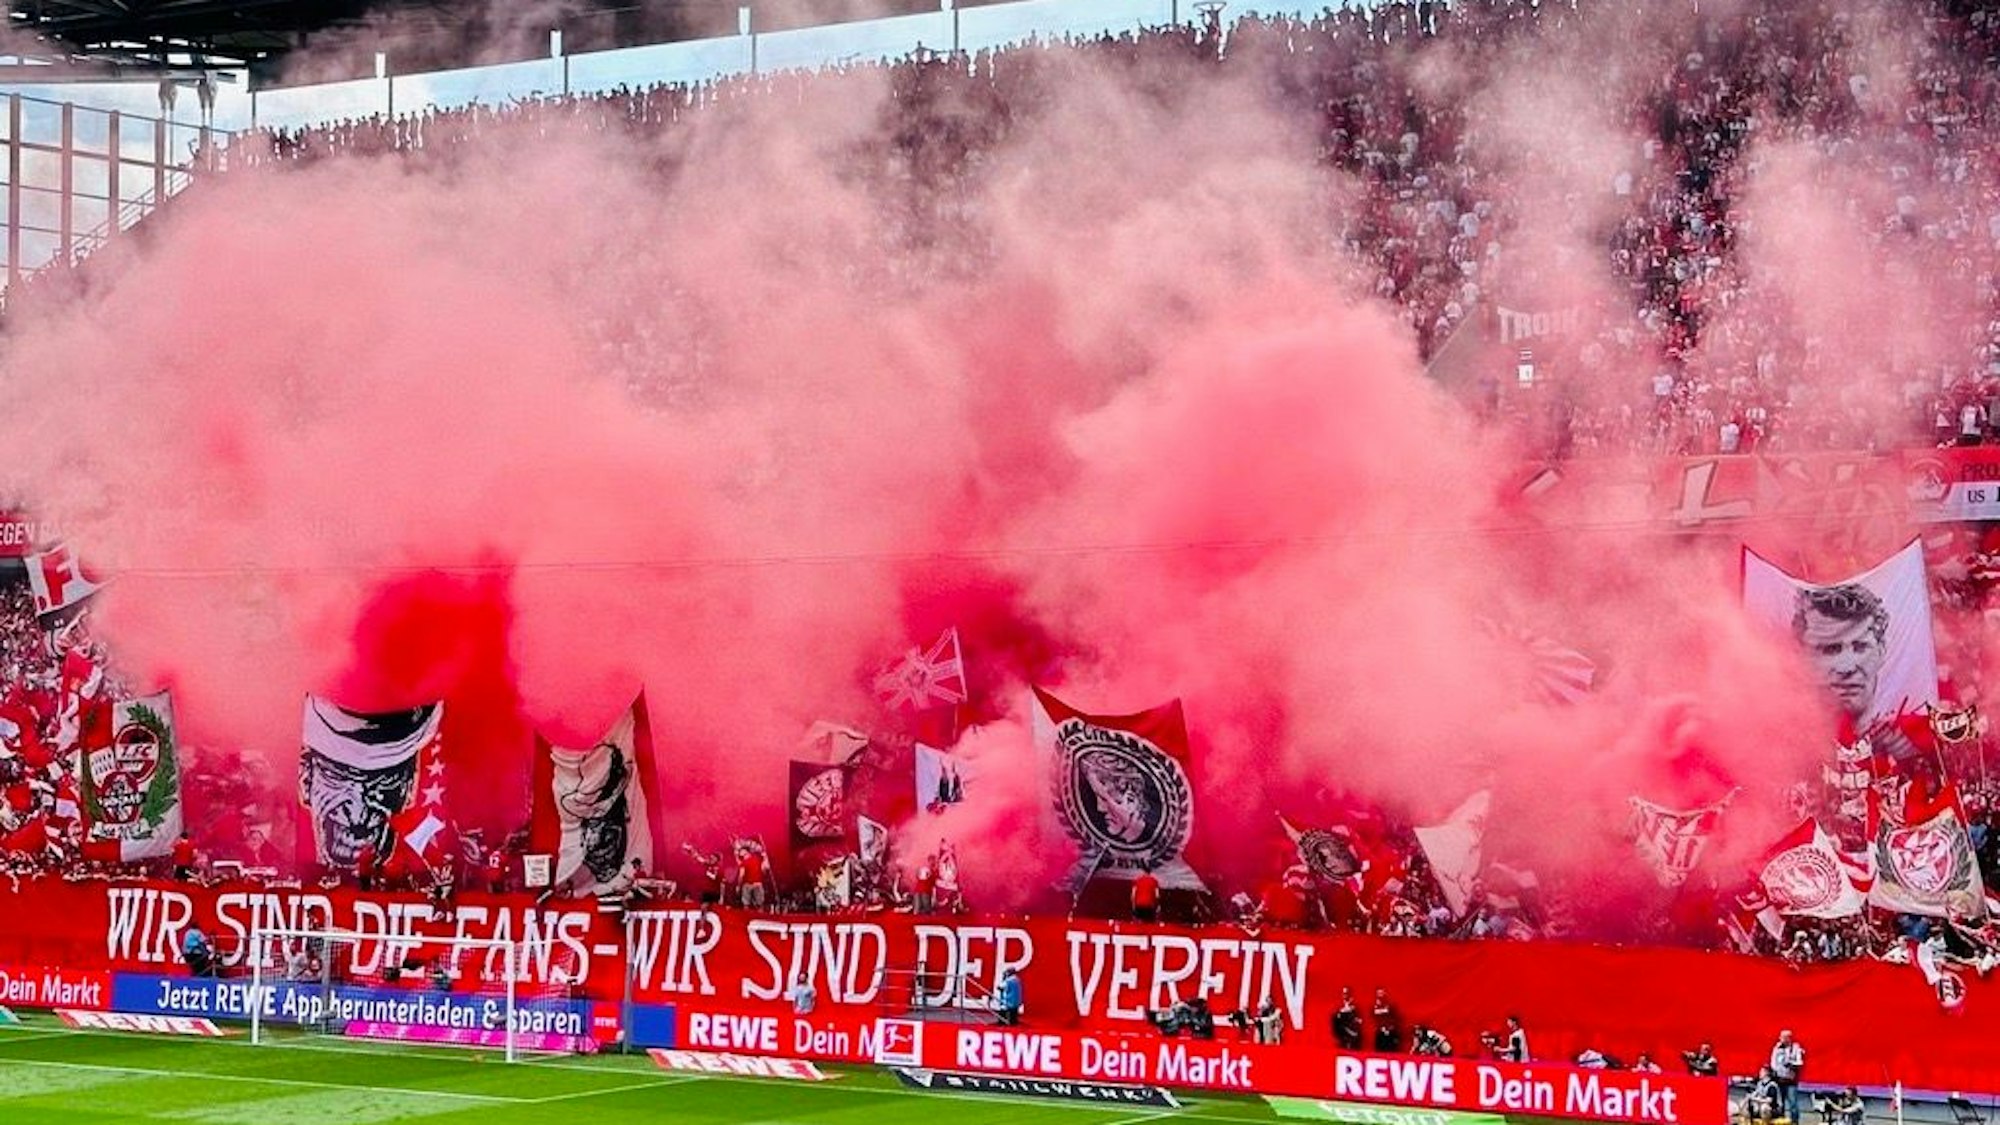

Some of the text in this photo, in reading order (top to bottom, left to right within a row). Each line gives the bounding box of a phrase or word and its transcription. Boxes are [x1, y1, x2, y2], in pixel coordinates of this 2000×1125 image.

[1967, 490, 1985, 503] US
[107, 887, 193, 965] WIR
[350, 900, 434, 978] DIE
[624, 910, 722, 996] WIR
[741, 919, 888, 1004] SIND
[911, 924, 1034, 1014] DER
[1065, 930, 1316, 1031] VEREIN
[41, 974, 102, 1006] Markt
[157, 981, 210, 1012] Jetzt
[215, 983, 276, 1015] REWE
[282, 988, 323, 1022] App
[329, 991, 475, 1029] herunterladen
[689, 1013, 778, 1050] REWE
[794, 1020, 849, 1056] Dein
[956, 1030, 1253, 1088] REWE Dein Markt
[1335, 1056, 1678, 1122] REWE Dein Markt
